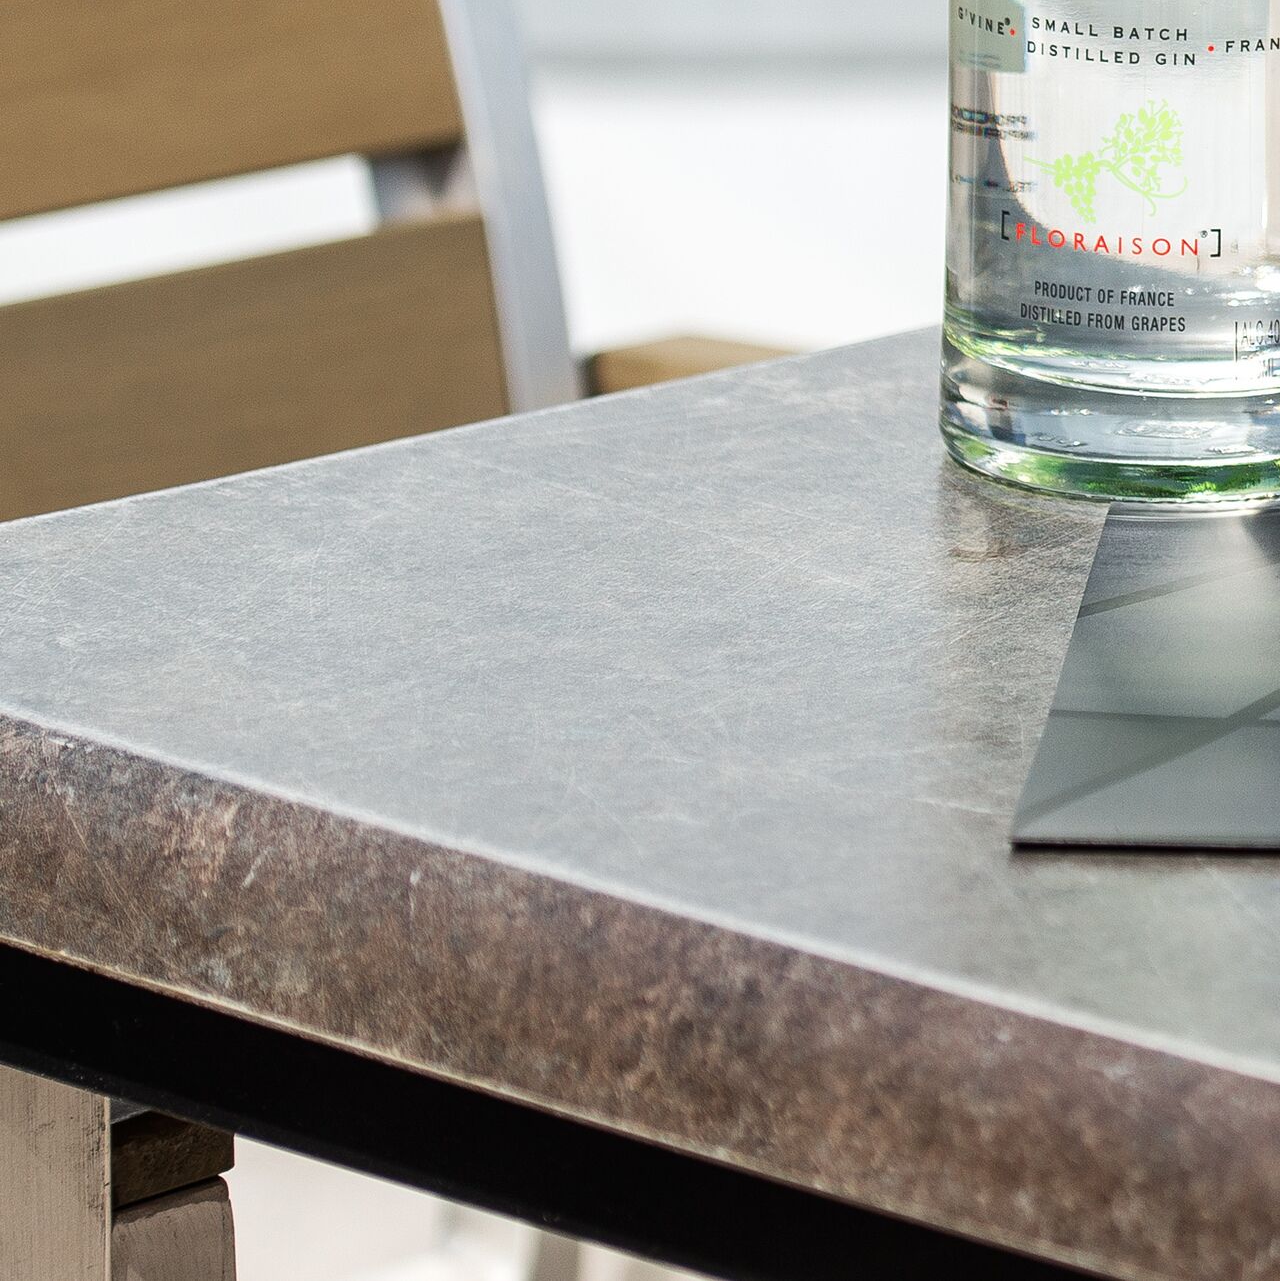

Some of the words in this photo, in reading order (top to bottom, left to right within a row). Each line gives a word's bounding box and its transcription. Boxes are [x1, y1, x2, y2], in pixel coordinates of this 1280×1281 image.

[957, 6, 1005, 36] G'VINE
[1031, 16, 1099, 38] SMALL
[1113, 25, 1189, 42] BATCH
[1026, 40, 1141, 65] DISTILLED
[1155, 52, 1197, 67] GIN
[1034, 280, 1093, 304] PRODUCT
[1097, 289, 1116, 305] OF
[1120, 289, 1175, 307] FRANCE
[1020, 303, 1082, 328] DISTILLED
[1087, 312, 1125, 331] FROM
[1131, 315, 1186, 333] GRAPES
